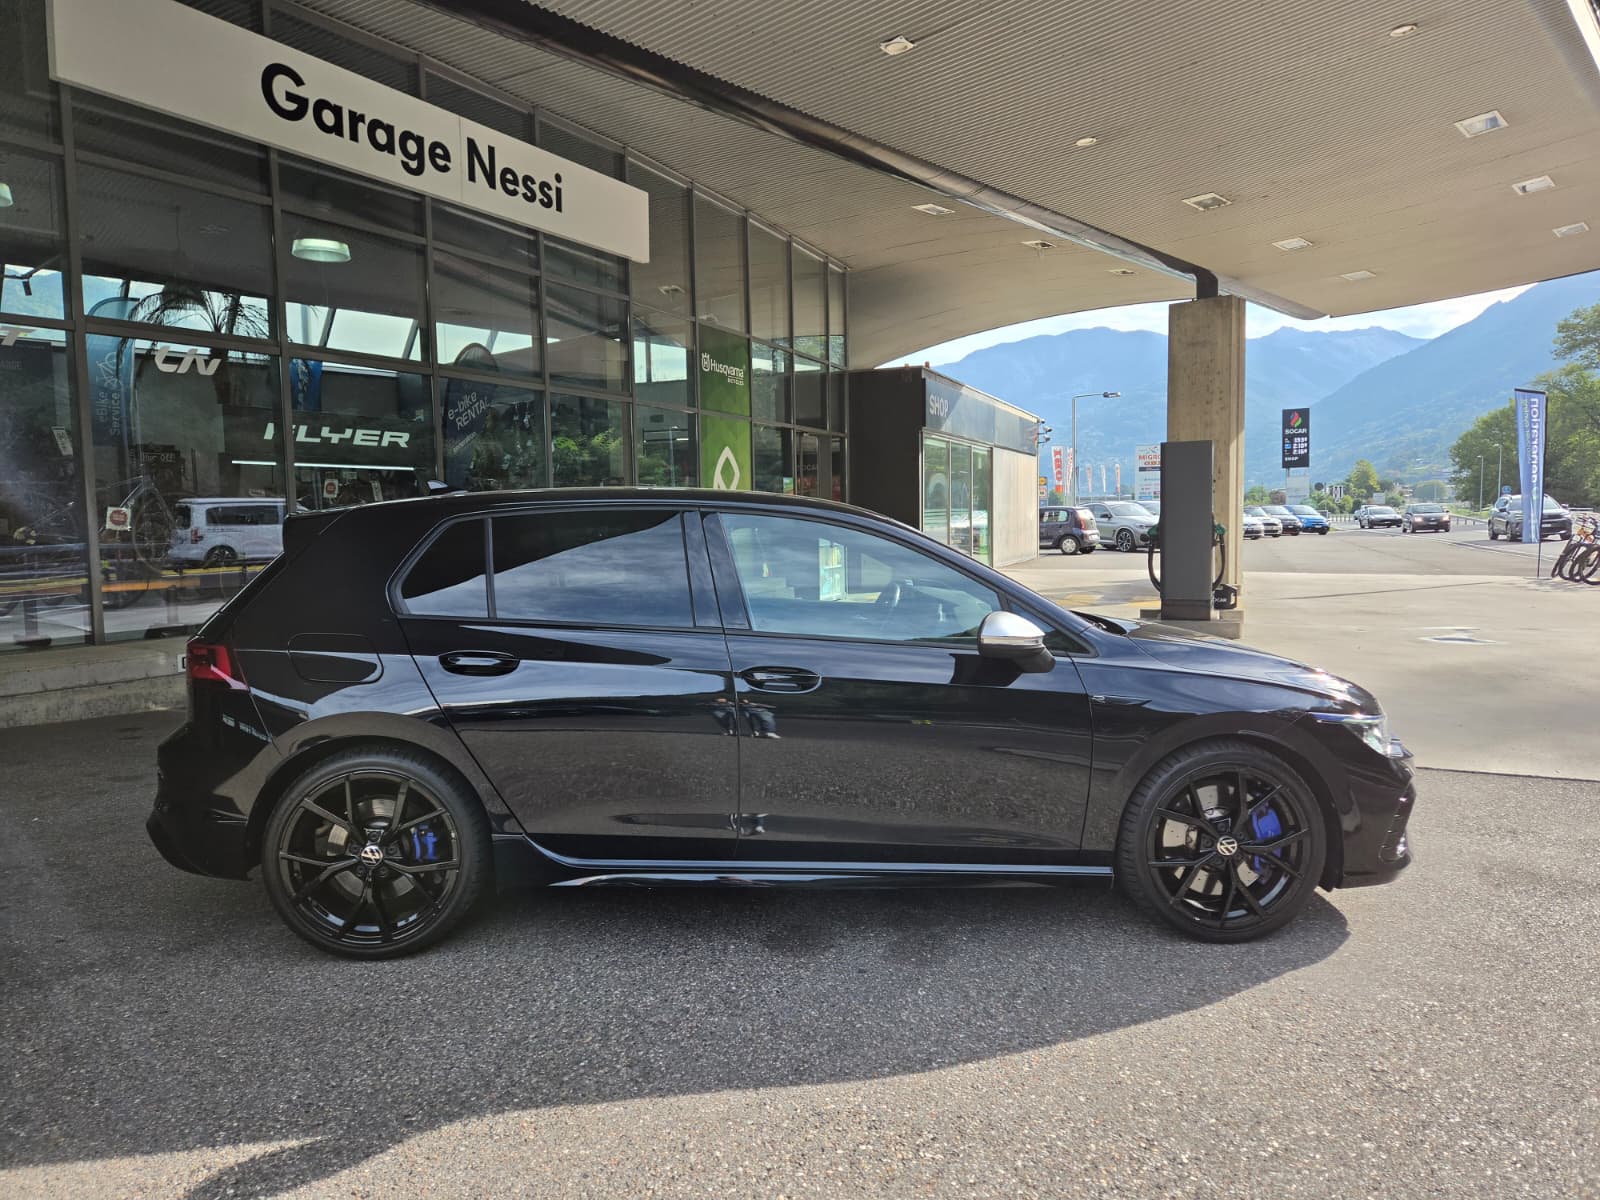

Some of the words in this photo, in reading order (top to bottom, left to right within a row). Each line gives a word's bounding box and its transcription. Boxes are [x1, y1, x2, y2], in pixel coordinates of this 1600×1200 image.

[261, 62, 451, 177] Garage
[466, 136, 563, 214] Nessi
[710, 358, 744, 378] Husqvarna
[455, 395, 491, 431] RENTAL
[929, 393, 949, 417] SHOP
